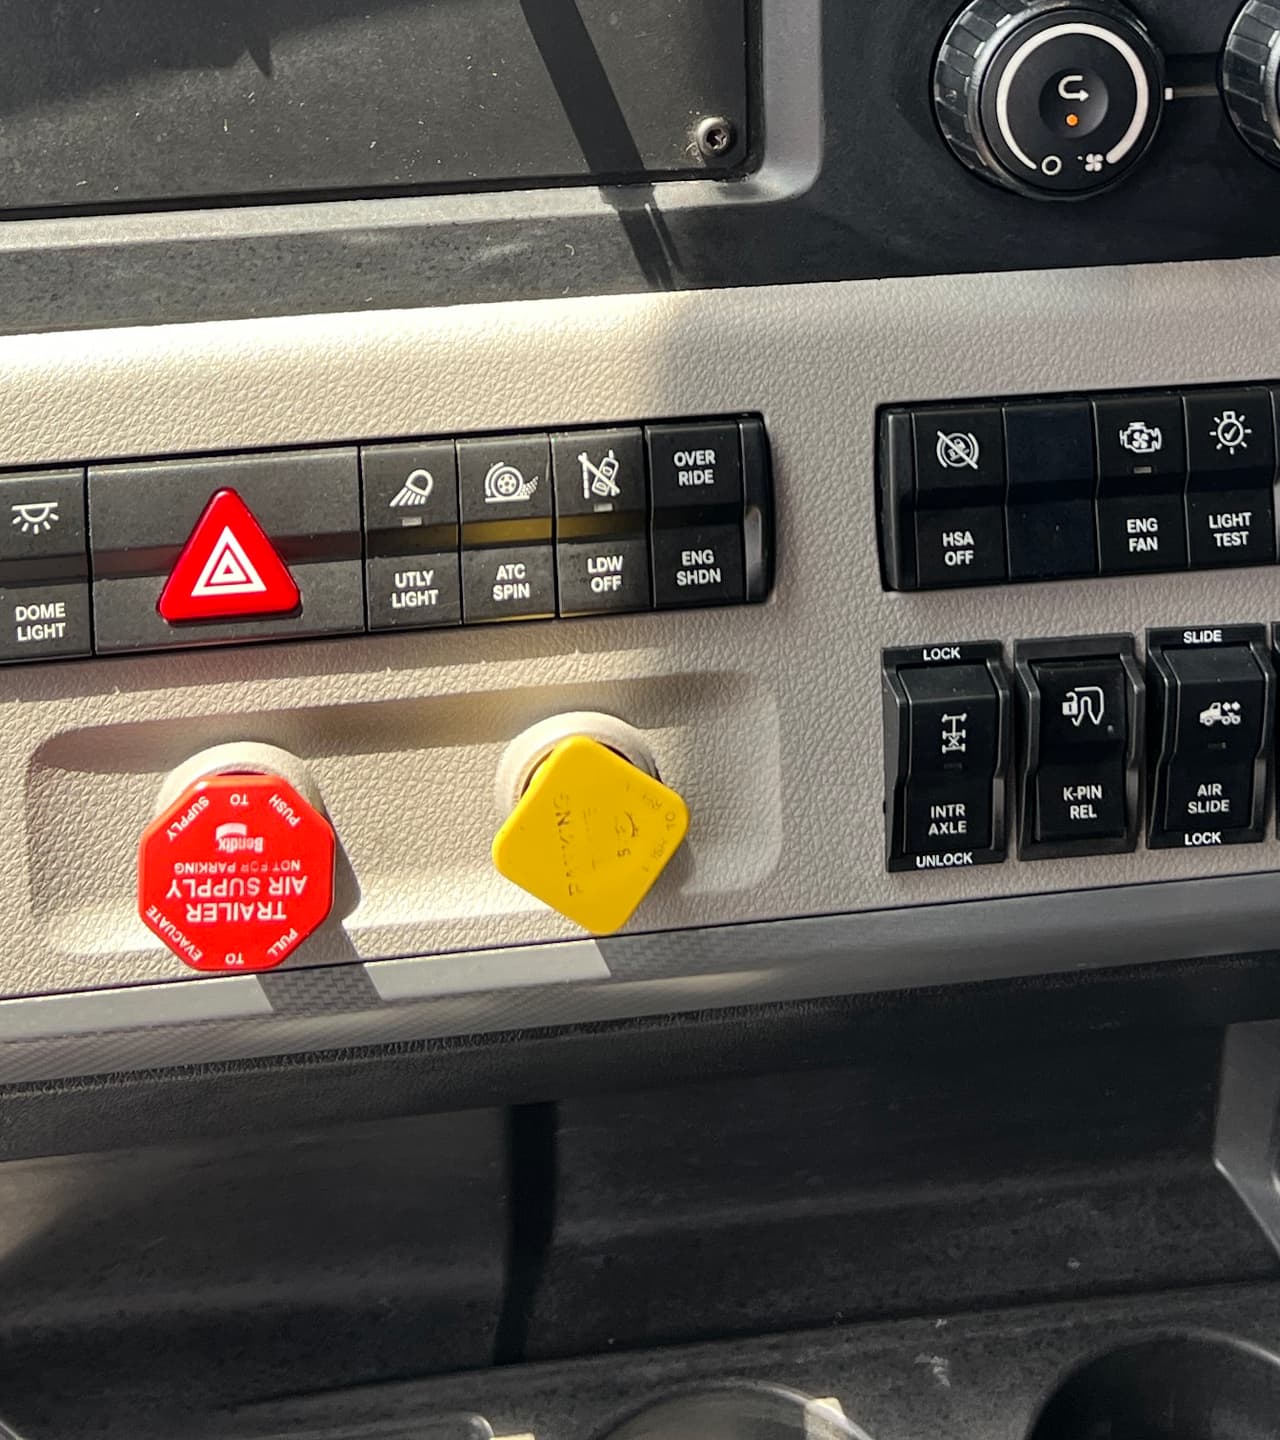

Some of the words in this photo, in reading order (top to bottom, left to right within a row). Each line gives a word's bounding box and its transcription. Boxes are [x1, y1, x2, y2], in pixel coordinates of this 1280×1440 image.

[673, 449, 716, 468] OVER
[678, 469, 715, 486] RIDE
[1126, 517, 1158, 534] ENG
[1208, 511, 1252, 530] LIGHT
[942, 531, 974, 548] HSA
[1128, 535, 1158, 552] FAN
[1214, 530, 1249, 548] TEST
[587, 556, 622, 574] LDW
[681, 549, 715, 567] ENG
[944, 549, 974, 567] OFF
[394, 569, 434, 589] UTLY
[495, 563, 526, 581] ATC
[675, 568, 721, 587] SHDN
[493, 582, 530, 601] SPIN
[590, 575, 622, 593] OFF
[391, 589, 439, 609] LIGHT
[15, 602, 66, 621] DOME
[16, 622, 66, 642] LIGHT
[1183, 629, 1222, 644] SLIDE
[923, 646, 961, 661] LOCK
[230, 793, 249, 806] TO
[1063, 785, 1103, 802] K-PIN
[1197, 783, 1222, 799] AIR
[268, 793, 301, 827] PUSH
[930, 803, 966, 819] INTR
[1070, 804, 1097, 820] REL
[1187, 799, 1230, 815] SLIDE
[166, 795, 210, 841] SUPPLY
[928, 819, 967, 836] AXLE
[1184, 831, 1222, 847] LOCK
[174, 861, 236, 873] PARKING
[240, 861, 268, 872] FOR
[273, 859, 300, 872] NOT
[916, 851, 973, 868] UNLOCK
[166, 877, 261, 898] SUPPLY
[269, 875, 307, 895] AIR
[186, 901, 287, 922] TRAILER
[145, 905, 204, 962] EVACUATE
[267, 928, 298, 957] PULL
[225, 952, 245, 965] TO
